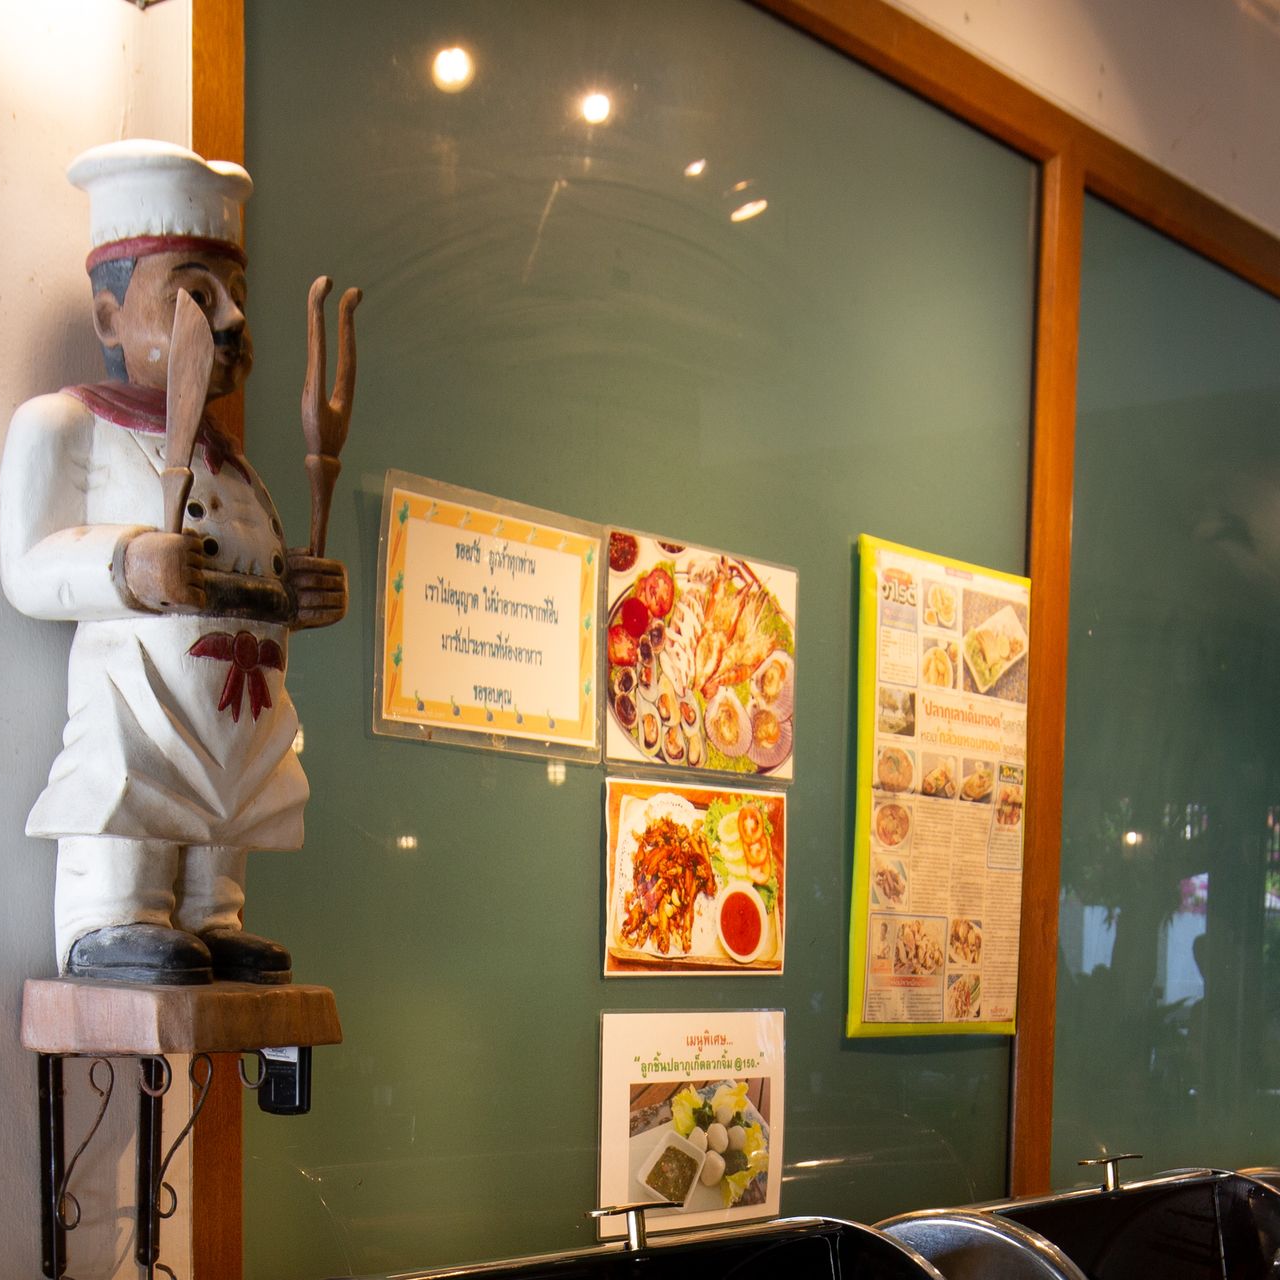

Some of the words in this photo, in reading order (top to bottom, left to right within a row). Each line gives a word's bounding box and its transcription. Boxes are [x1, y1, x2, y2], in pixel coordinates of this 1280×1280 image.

[488, 541, 536, 580] ลูกค้าทุกท่าน
[425, 576, 479, 616] เราไม่อนุญาต
[482, 585, 559, 624] ให้นำอาหารจากที่อื่น
[441, 626, 543, 666] มารับประทานที่ห้องอาหาร
[473, 684, 512, 712] ขอขอบคุณ
